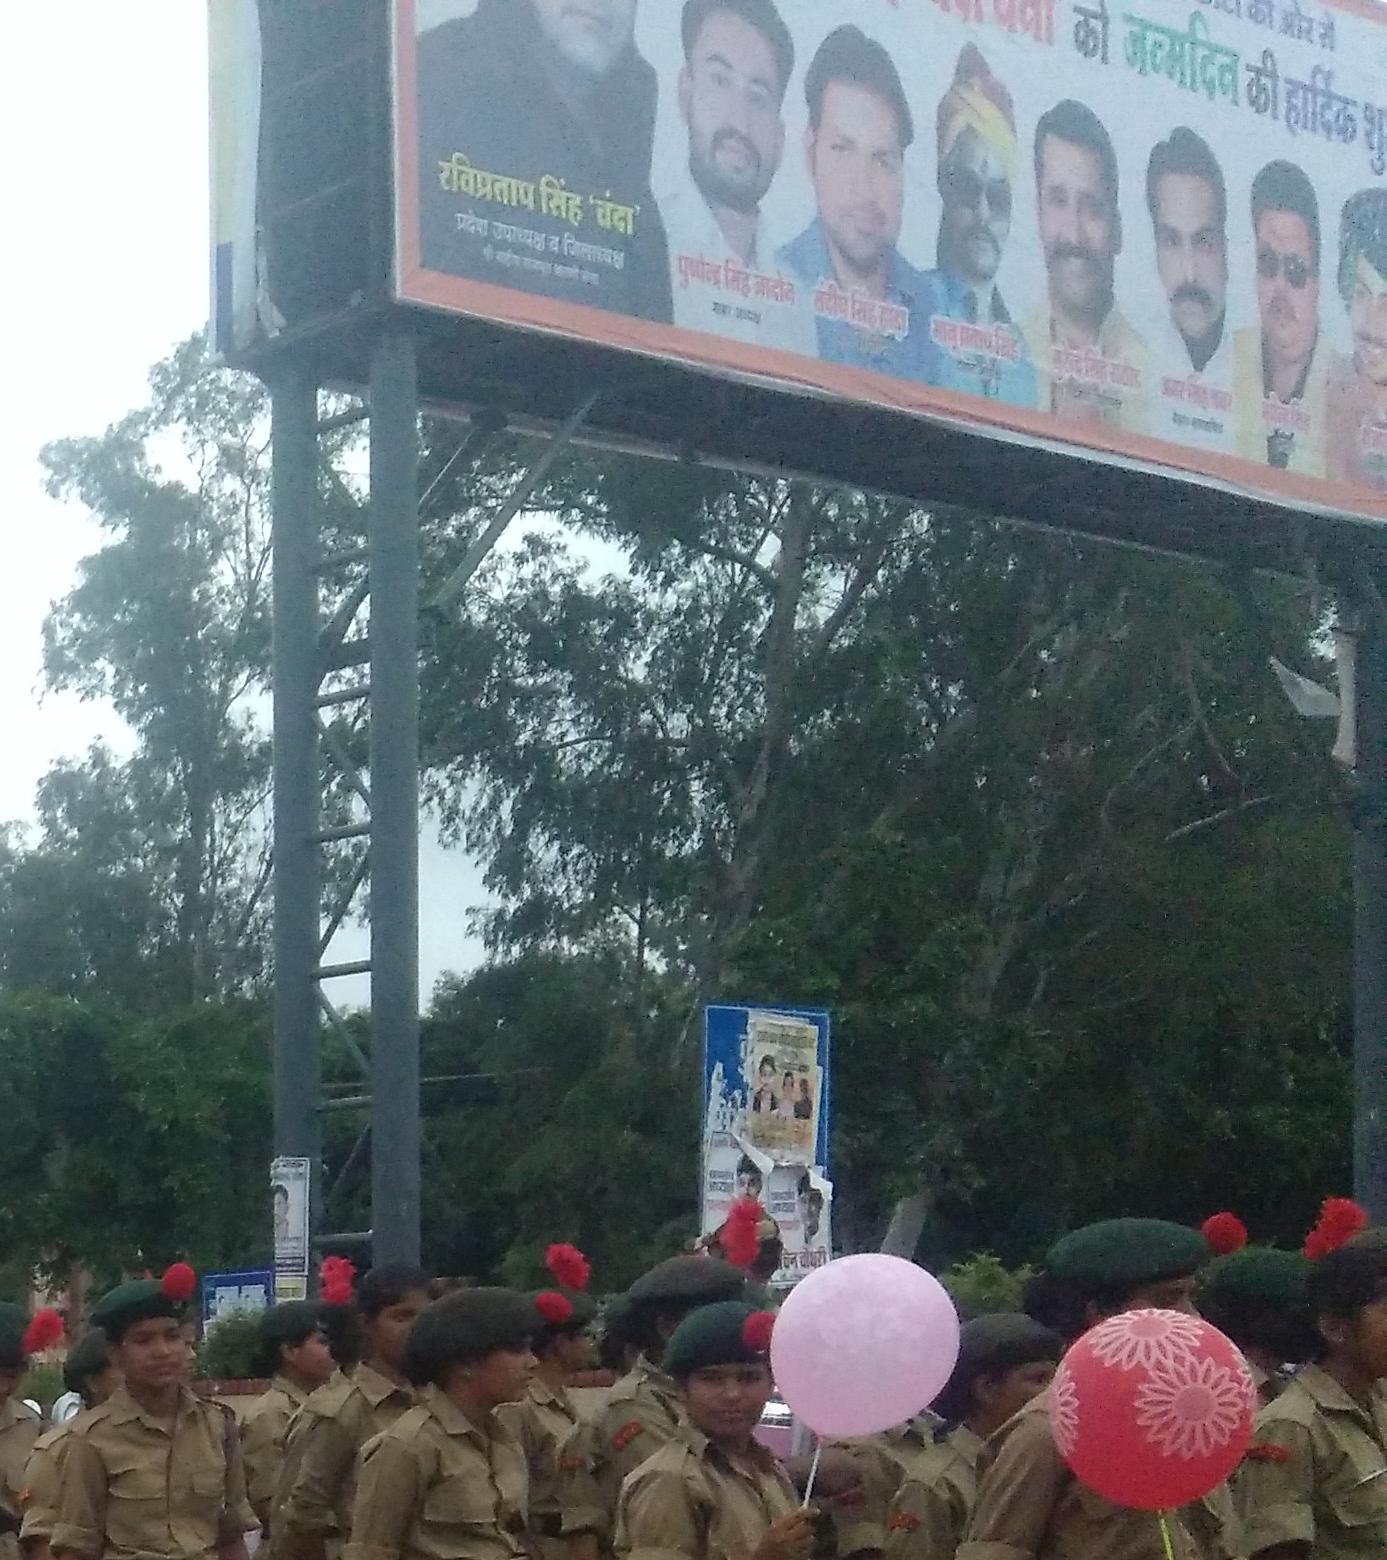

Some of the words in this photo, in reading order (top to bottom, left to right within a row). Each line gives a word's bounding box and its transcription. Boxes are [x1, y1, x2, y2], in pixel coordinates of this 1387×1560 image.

[1125, 11, 1240, 107] जन्मदिन
[1245, 48, 1279, 120] की
[1283, 65, 1357, 144] हार्दिक
[438, 152, 535, 211] रविप्रताप
[538, 174, 584, 227] सिंह
